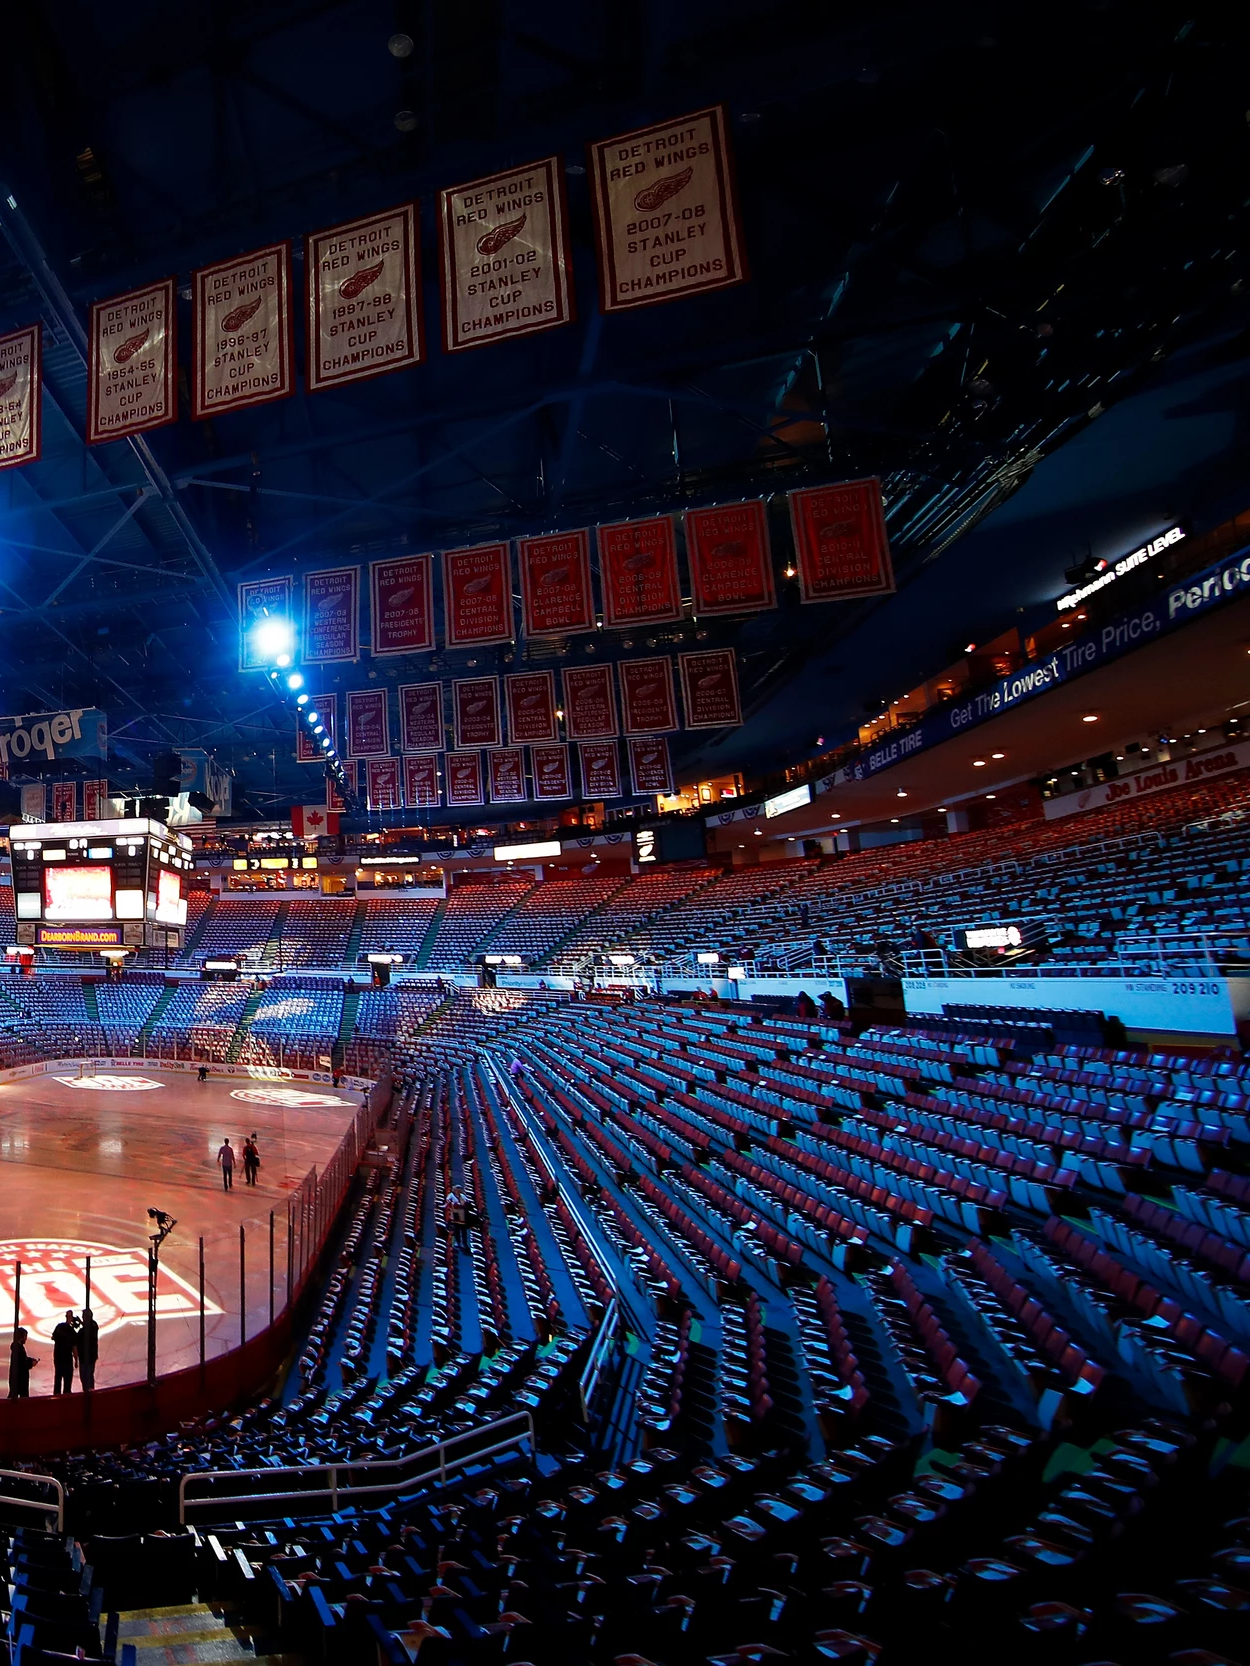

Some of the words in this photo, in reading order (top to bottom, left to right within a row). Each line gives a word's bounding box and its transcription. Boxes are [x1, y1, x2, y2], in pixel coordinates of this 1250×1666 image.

[619, 128, 696, 161] DETROIT
[610, 161, 645, 181] RED
[655, 143, 710, 169] WINGS
[464, 178, 534, 208] DETROIT
[457, 209, 487, 226] RED
[496, 192, 544, 215] WINGS
[627, 205, 705, 235] 2007-08
[329, 227, 391, 255] DETROIT
[628, 222, 707, 254] STANLEY
[323, 256, 349, 272] RED
[357, 240, 400, 261] WINGS
[651, 249, 686, 267] CUP
[470, 251, 537, 278] 2001-02
[214, 262, 268, 289] DETROIT
[468, 267, 541, 296] STANLEY
[619, 259, 723, 293] CHAMPIONS
[208, 291, 231, 305] RED
[238, 276, 275, 296] WINGS
[333, 293, 391, 319] 1997-98
[490, 290, 522, 308] CUP
[108, 297, 156, 321] DETROIT
[102, 323, 123, 337] RED
[130, 311, 162, 328] WINGS
[330, 308, 395, 337] STANLEY
[462, 301, 554, 333] CHAMPIONS
[217, 328, 267, 352] 1996-97
[348, 331, 377, 347] CUP
[214, 341, 269, 368] STANLEY
[323, 340, 404, 370] CHAMPIONS
[0, 355, 29, 371] WINGS
[108, 359, 155, 380] 1954-55
[229, 363, 255, 378] CUP
[106, 373, 157, 396] STANLEY
[207, 373, 278, 400] CHAMPIONS
[120, 392, 143, 406] CUP
[100, 402, 163, 426] CHAMPIONS
[702, 514, 747, 527] DETROIT
[724, 523, 754, 533] WINGS
[615, 528, 657, 542] DETROIT
[534, 543, 573, 555] DETROIT
[610, 542, 630, 552] RED
[634, 537, 664, 548] WINGS
[821, 541, 860, 553] 2010-11
[1115, 549, 1148, 575] SUITE
[1147, 527, 1186, 557] LEVEL
[457, 555, 495, 567] DETROIT
[530, 555, 547, 565] RED
[552, 552, 578, 562] WINGS
[817, 552, 867, 565] CENTRAL
[383, 566, 417, 577] DETROIT
[453, 566, 471, 576] RED
[474, 563, 500, 572] WINGS
[619, 570, 662, 583] 2008-09
[703, 568, 758, 581] CLARENCE
[818, 562, 870, 576] DIVISION
[380, 577, 395, 586] RED
[398, 574, 422, 583] WINGS
[704, 580, 758, 593] CAMPBELL
[814, 574, 878, 588] CHAMPIONS
[537, 584, 576, 596] 2007-08
[619, 582, 663, 594] CENTRAL
[460, 595, 497, 606] 2007-08
[533, 593, 581, 606] CLARENCE
[619, 592, 665, 605] DIVISION
[718, 592, 746, 601] BOWL
[384, 608, 419, 619] 2007-08
[460, 605, 497, 616] CENTRAL
[534, 604, 581, 617] CAMPBELL
[615, 601, 671, 616] CHAMPIONS
[460, 615, 499, 625] DIVISION
[546, 617, 571, 625] BOWL
[388, 629, 417, 639] TROPHY
[456, 623, 503, 636] CHAMPIONS
[950, 706, 973, 728] Get
[975, 687, 1001, 719] The
[1003, 656, 1059, 703] Lowest
[1062, 644, 1096, 672] Tire
[1102, 611, 1161, 653] Price,
[869, 743, 898, 770] BELLE
[899, 730, 923, 753] TIRE
[1106, 782, 1130, 801] Joe
[1136, 766, 1178, 793] Louis
[1185, 752, 1238, 780] Arena
[1172, 983, 1195, 994] 209
[1199, 983, 1219, 995] 210
[25, 1243, 104, 1256] SEASON
